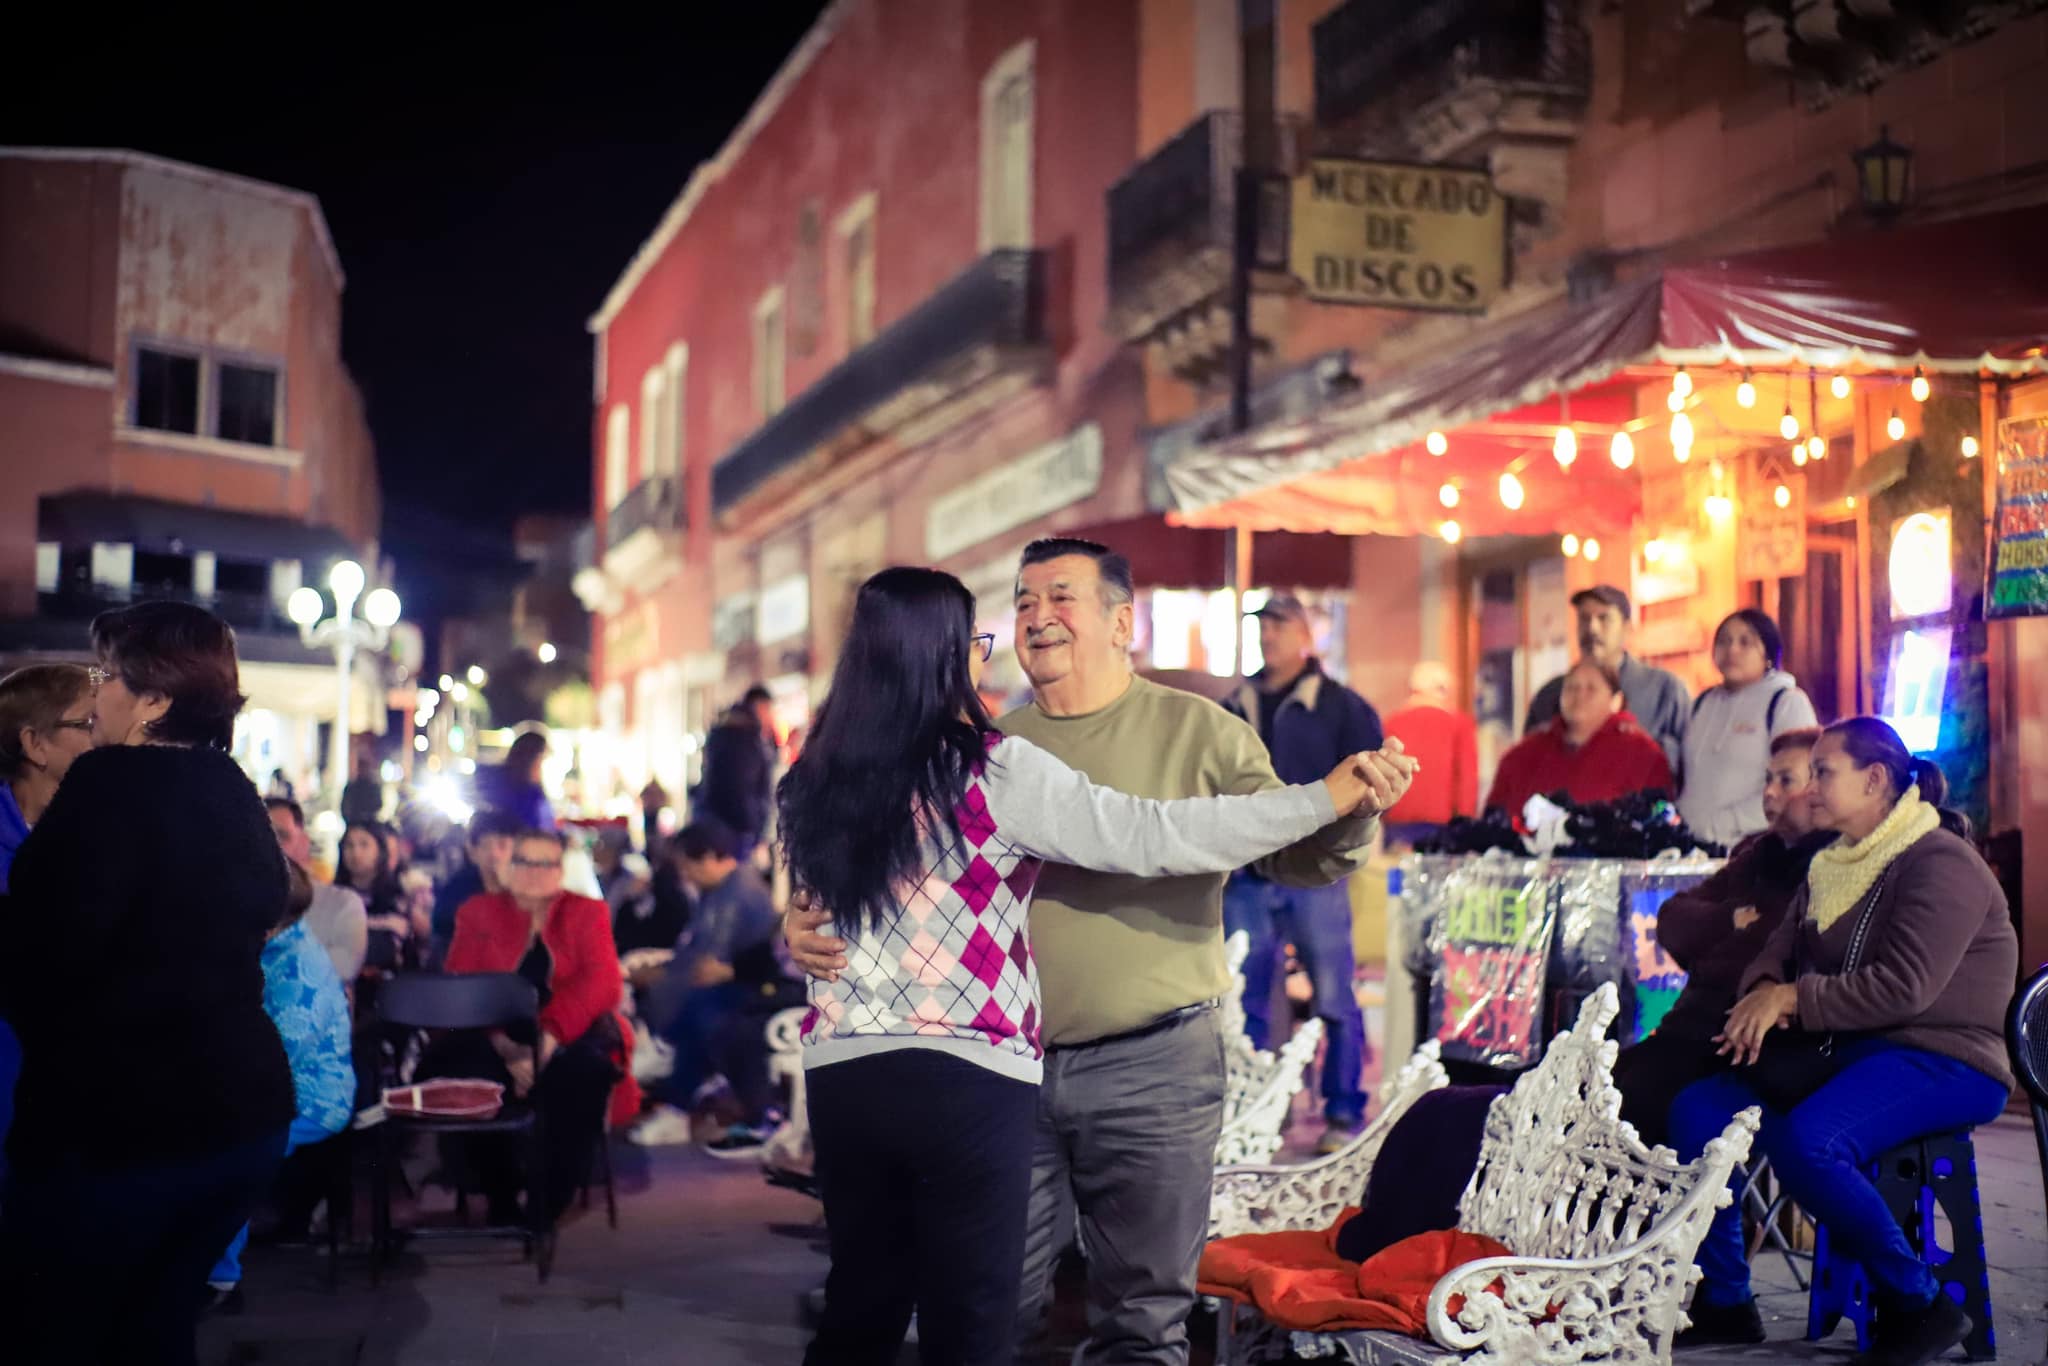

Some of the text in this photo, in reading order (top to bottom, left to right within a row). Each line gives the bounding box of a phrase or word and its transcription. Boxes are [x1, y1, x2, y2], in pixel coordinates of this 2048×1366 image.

[1311, 168, 1491, 217] MERCADO
[1366, 212, 1414, 252] DE
[1314, 255, 1479, 302] DISCOS
